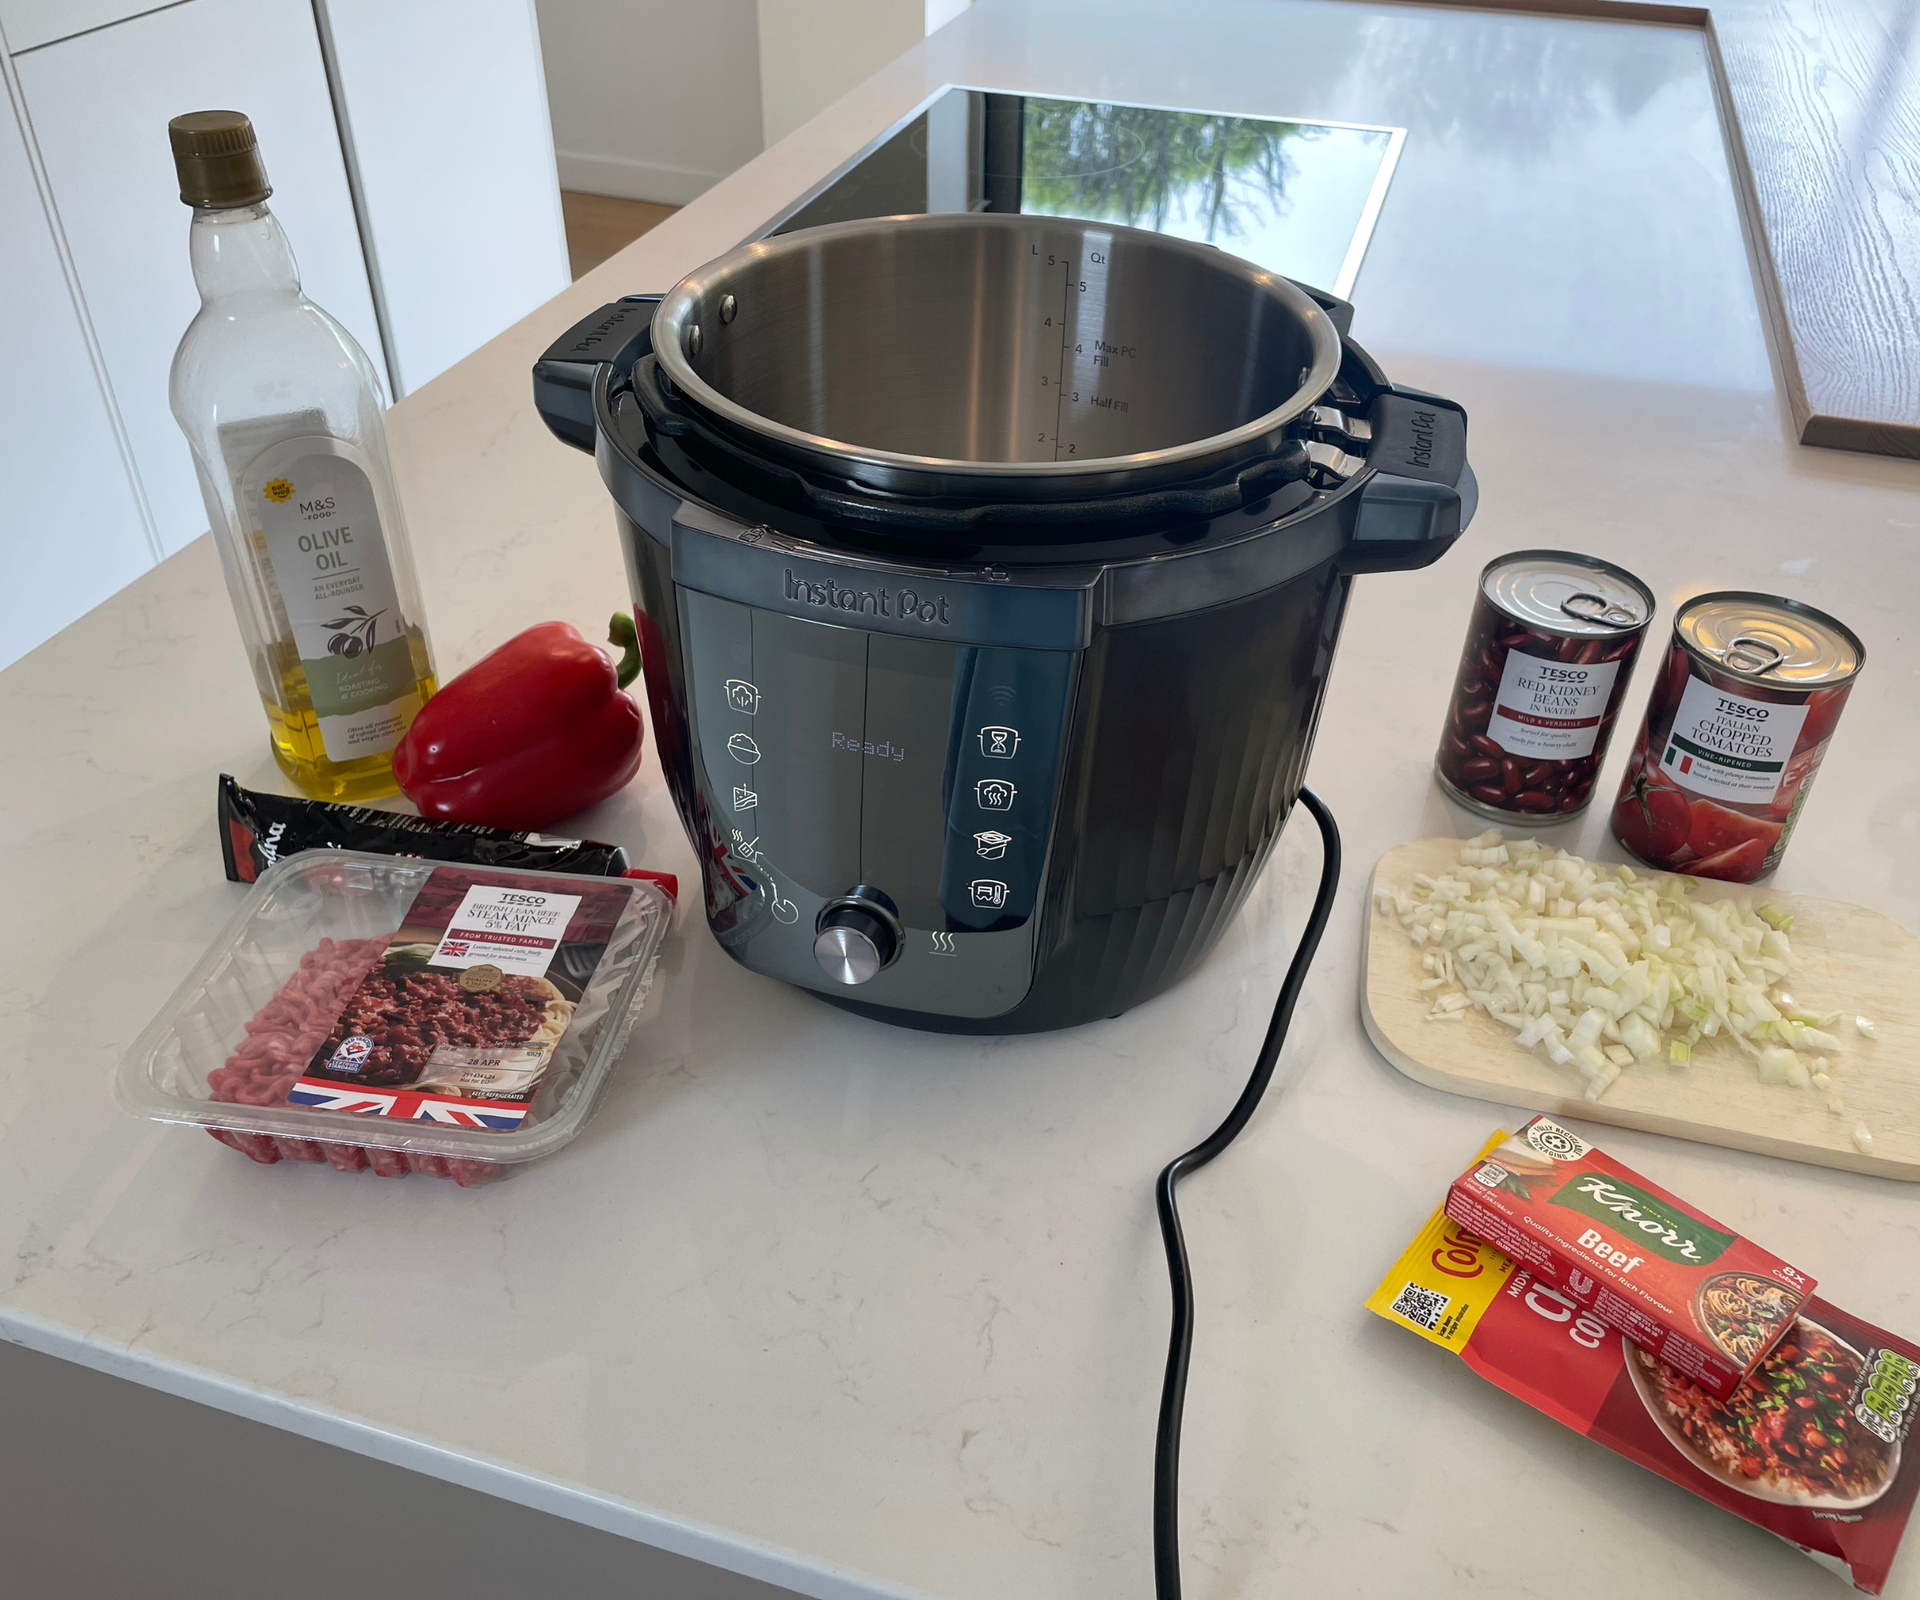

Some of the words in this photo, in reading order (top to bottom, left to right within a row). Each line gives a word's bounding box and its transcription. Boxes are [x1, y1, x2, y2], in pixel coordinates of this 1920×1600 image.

[1032, 244, 1038, 255] L
[1048, 255, 1055, 266] 5
[1091, 252, 1106, 265] Qt
[1079, 281, 1087, 292] 5
[1044, 317, 1052, 327] 4
[1075, 343, 1083, 354] 4
[1095, 340, 1118, 355] Max
[1121, 345, 1137, 359] PC
[1093, 355, 1109, 368] Fill
[1041, 376, 1048, 386] 3
[1072, 392, 1079, 402] 3
[1091, 396, 1113, 411] Half
[1114, 400, 1129, 413] Fill
[1411, 411, 1436, 429] Pot
[1038, 433, 1045, 443] 2
[1069, 444, 1076, 453] 2
[1405, 429, 1433, 468] Instant
[271, 483, 285, 491] eat
[273, 487, 290, 496] well
[300, 497, 335, 514] M&S
[298, 526, 353, 552] OLIVE
[316, 551, 348, 570] OIL
[326, 576, 360, 590] EVERYDAY
[315, 584, 364, 600] ALL-ROUNDER
[784, 568, 889, 616] Instant
[896, 590, 949, 624] Pot
[1540, 666, 1588, 680] TESCO
[340, 678, 379, 692] ROASTING
[351, 683, 388, 697] COOKING
[1518, 677, 1546, 692] RED
[1549, 685, 1600, 696] KIDNEY
[1533, 693, 1580, 707] BEANS
[1544, 707, 1576, 715] WATER
[1718, 698, 1769, 719] TESCO
[1518, 714, 1535, 723] MILD
[1716, 716, 1761, 732] ITALIAN
[1520, 727, 1540, 736] Sorted
[1699, 720, 1771, 746] CHOPPED
[832, 731, 905, 761] Ready
[1691, 727, 1773, 758] TOMATOES
[1698, 749, 1752, 768] VINE-RIPENED
[1696, 761, 1711, 770] Made
[1712, 766, 1725, 775] with
[1725, 771, 1744, 780] plump
[1709, 776, 1730, 787] selected
[501, 893, 546, 904] TESCO
[472, 903, 509, 914] BRITISH
[509, 907, 536, 915] LEAN
[468, 910, 508, 921] STEAK
[513, 914, 556, 925] MINCE
[485, 920, 502, 929] 5%
[505, 922, 530, 932] FAT
[1530, 1137, 1568, 1160] PACKAGING
[1467, 1178, 1488, 1191] Energy
[1577, 1177, 1702, 1259] Knorr
[1642, 1205, 1661, 1219] SINCE
[1577, 1228, 1645, 1273] Beef
[1523, 1216, 1553, 1238] Quality
[1555, 1235, 1604, 1270] Ingredients
[1604, 1267, 1618, 1279] for
[1618, 1275, 1638, 1293] Rich
[1639, 1289, 1674, 1314] Flavour
[1772, 1269, 1801, 1289] Cubes
[1562, 1284, 1590, 1304] Unilever
